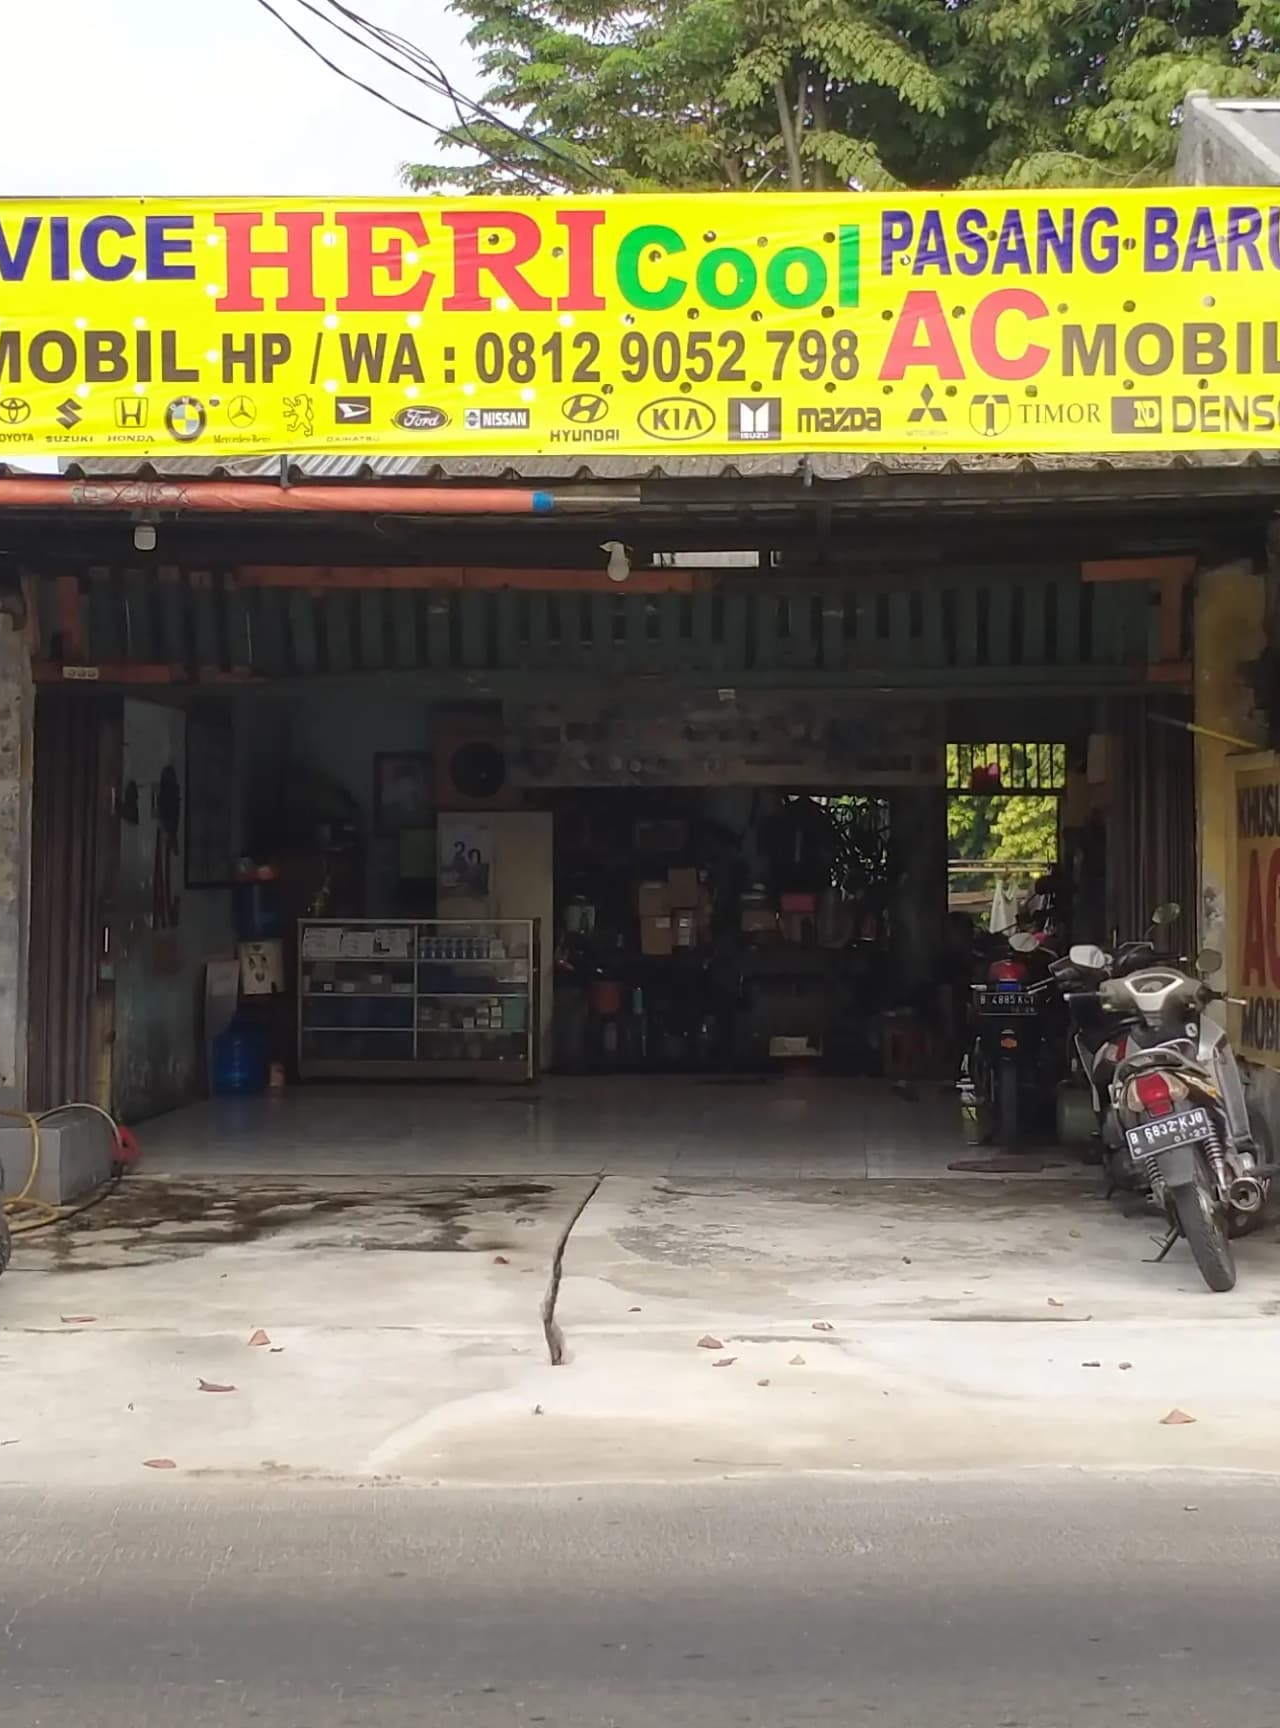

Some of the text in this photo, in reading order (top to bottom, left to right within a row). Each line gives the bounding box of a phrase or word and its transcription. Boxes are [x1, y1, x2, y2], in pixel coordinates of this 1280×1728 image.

[880, 207, 1119, 275] PASANG
[213, 210, 860, 313] HERI Cool
[878, 288, 1050, 381] AC
[222, 332, 292, 384] HP
[310, 332, 323, 385] /
[339, 333, 425, 384] WA
[475, 331, 601, 384] 0812
[620, 330, 746, 382] 9052
[766, 329, 859, 381] 798
[403, 409, 441, 427] Ford
[482, 411, 527, 427] NISSAN
[652, 407, 703, 430] KIA
[1018, 403, 1101, 424] TIMOR
[45, 435, 94, 443] SUZUKI
[549, 429, 619, 442] HYUNDAI
